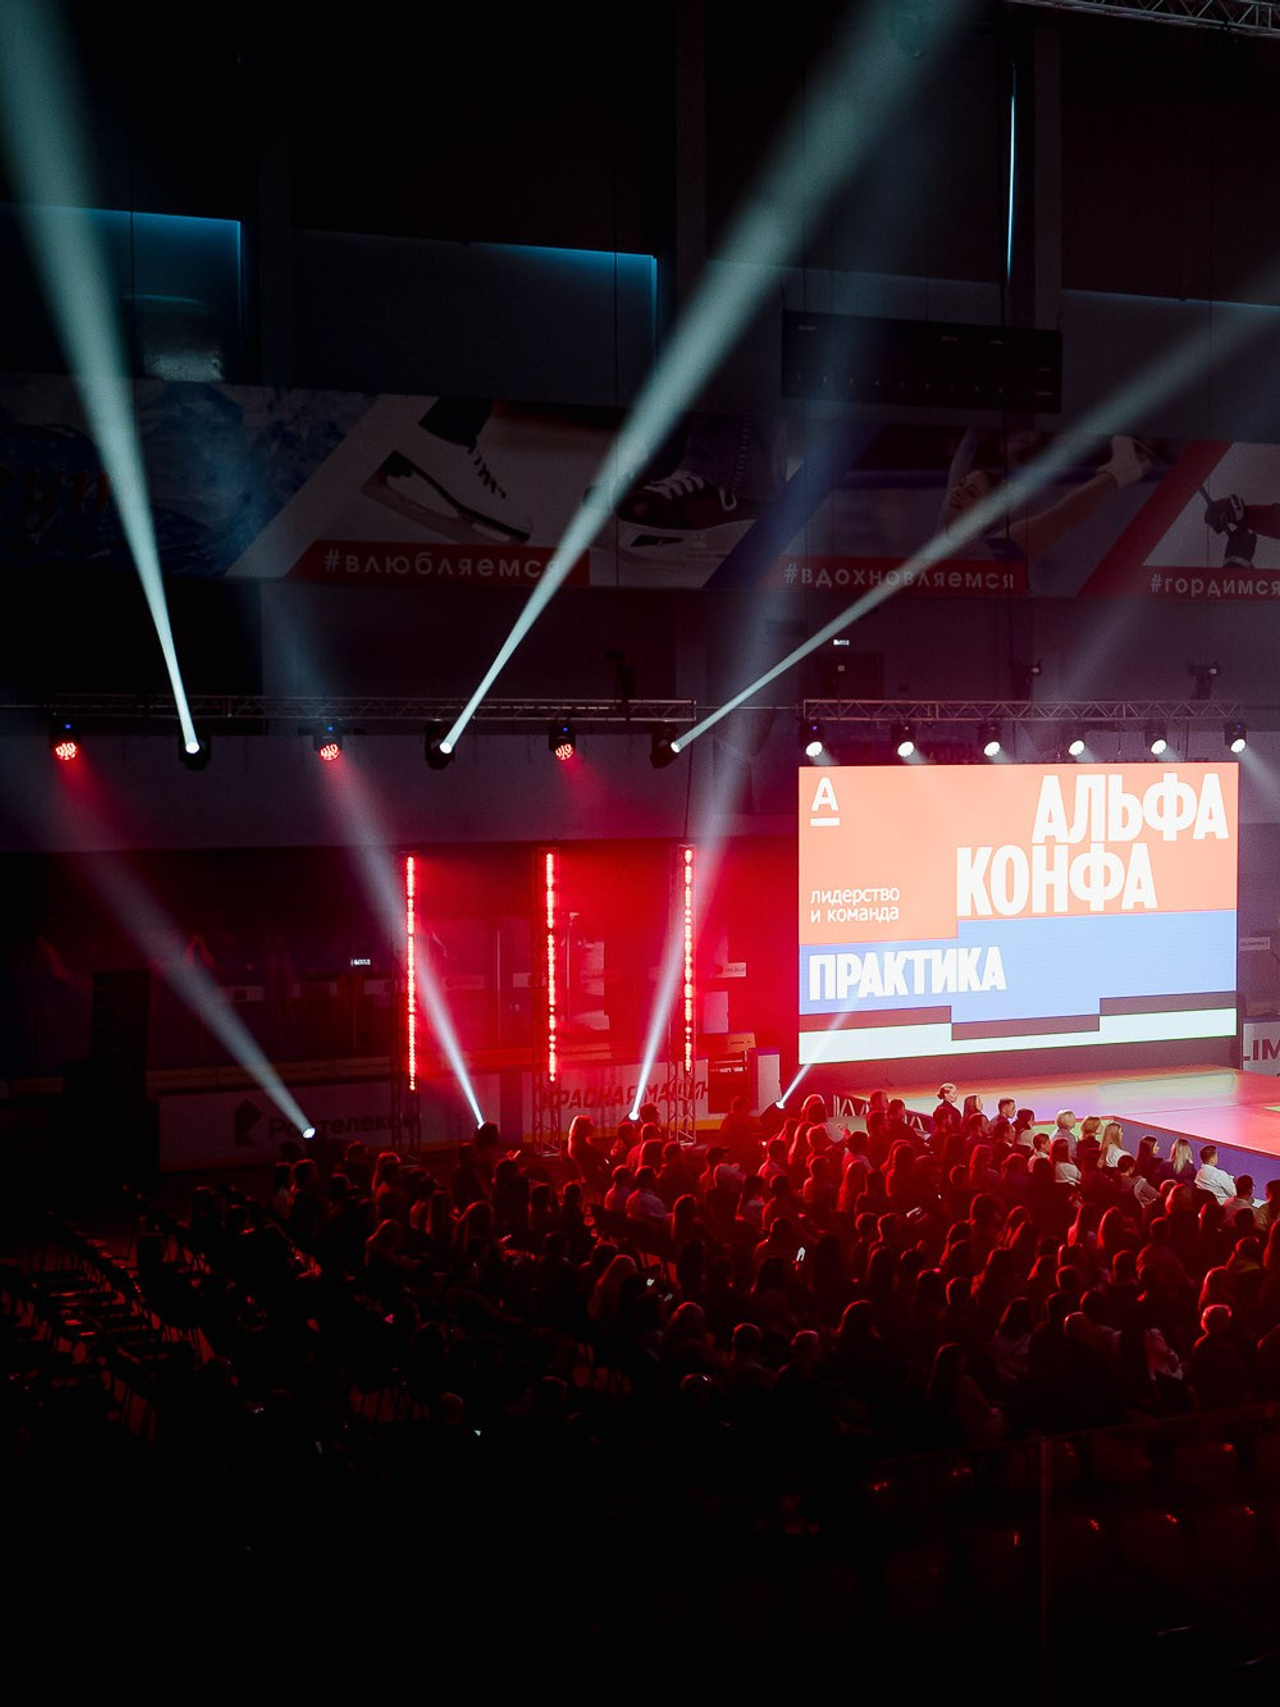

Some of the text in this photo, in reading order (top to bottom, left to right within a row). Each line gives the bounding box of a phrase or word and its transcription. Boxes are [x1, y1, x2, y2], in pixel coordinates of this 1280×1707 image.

[324, 548, 560, 579] #влюбляемс
[784, 563, 1015, 590] #вдохновляемся
[1032, 772, 1229, 844] АЛЬФА
[957, 842, 1158, 916] КОНФА
[810, 887, 900, 906] лидерство
[810, 906, 899, 923] и команда
[808, 946, 1006, 1001] ПРАКТИКА
